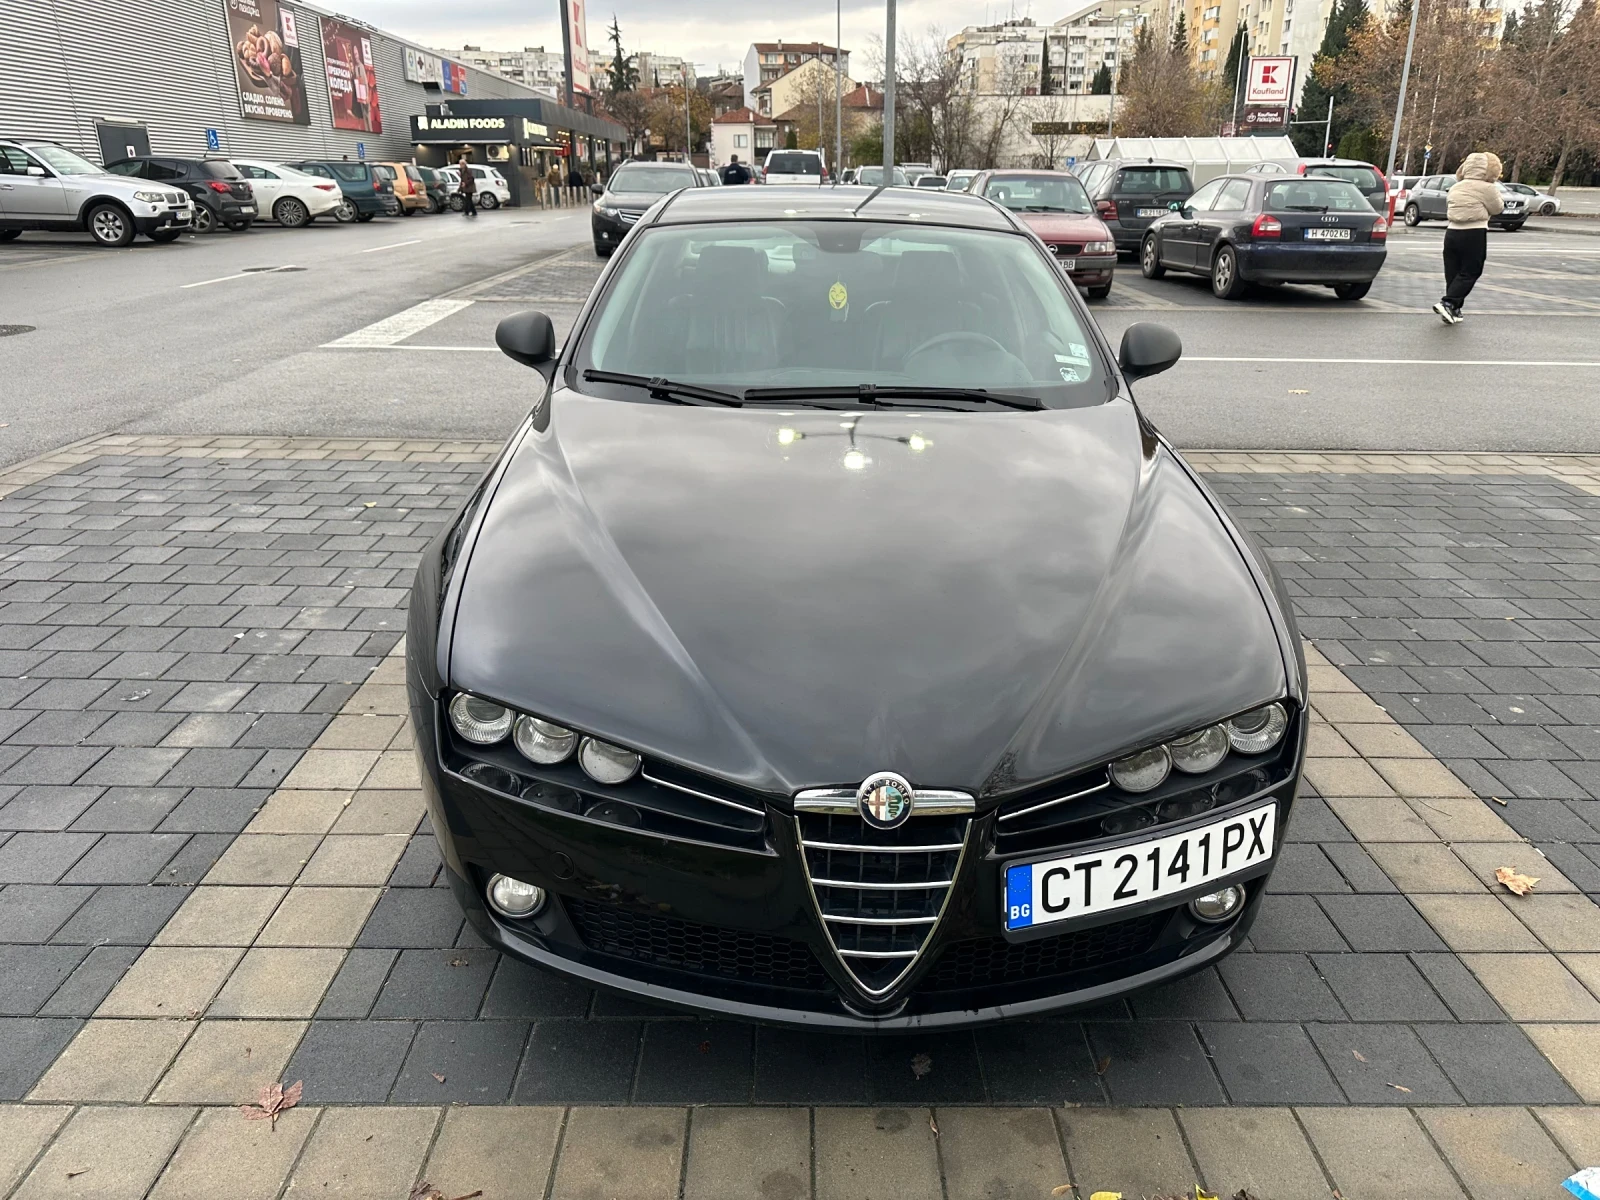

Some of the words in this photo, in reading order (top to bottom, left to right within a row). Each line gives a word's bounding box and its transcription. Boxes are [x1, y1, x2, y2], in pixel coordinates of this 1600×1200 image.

[1262, 66, 1279, 83] K
[330, 75, 353, 93] КОЛЕДА
[243, 92, 265, 104] СЛАДКО.
[265, 95, 286, 107] СОЛЕНО.
[244, 104, 265, 115] ВКУСНО.
[265, 106, 293, 119] ПРОВЕРЕНО.
[430, 118, 469, 129] ALADIN
[469, 118, 506, 129] FOODS
[1311, 229, 1318, 238] H
[1320, 229, 1339, 238] 4702
[1340, 229, 1349, 238] KB
[885, 779, 910, 804] ROMEO
[1041, 859, 1102, 913] CT
[1113, 833, 1211, 900] 2141
[1221, 812, 1268, 870] PX
[1010, 904, 1031, 920] BG
